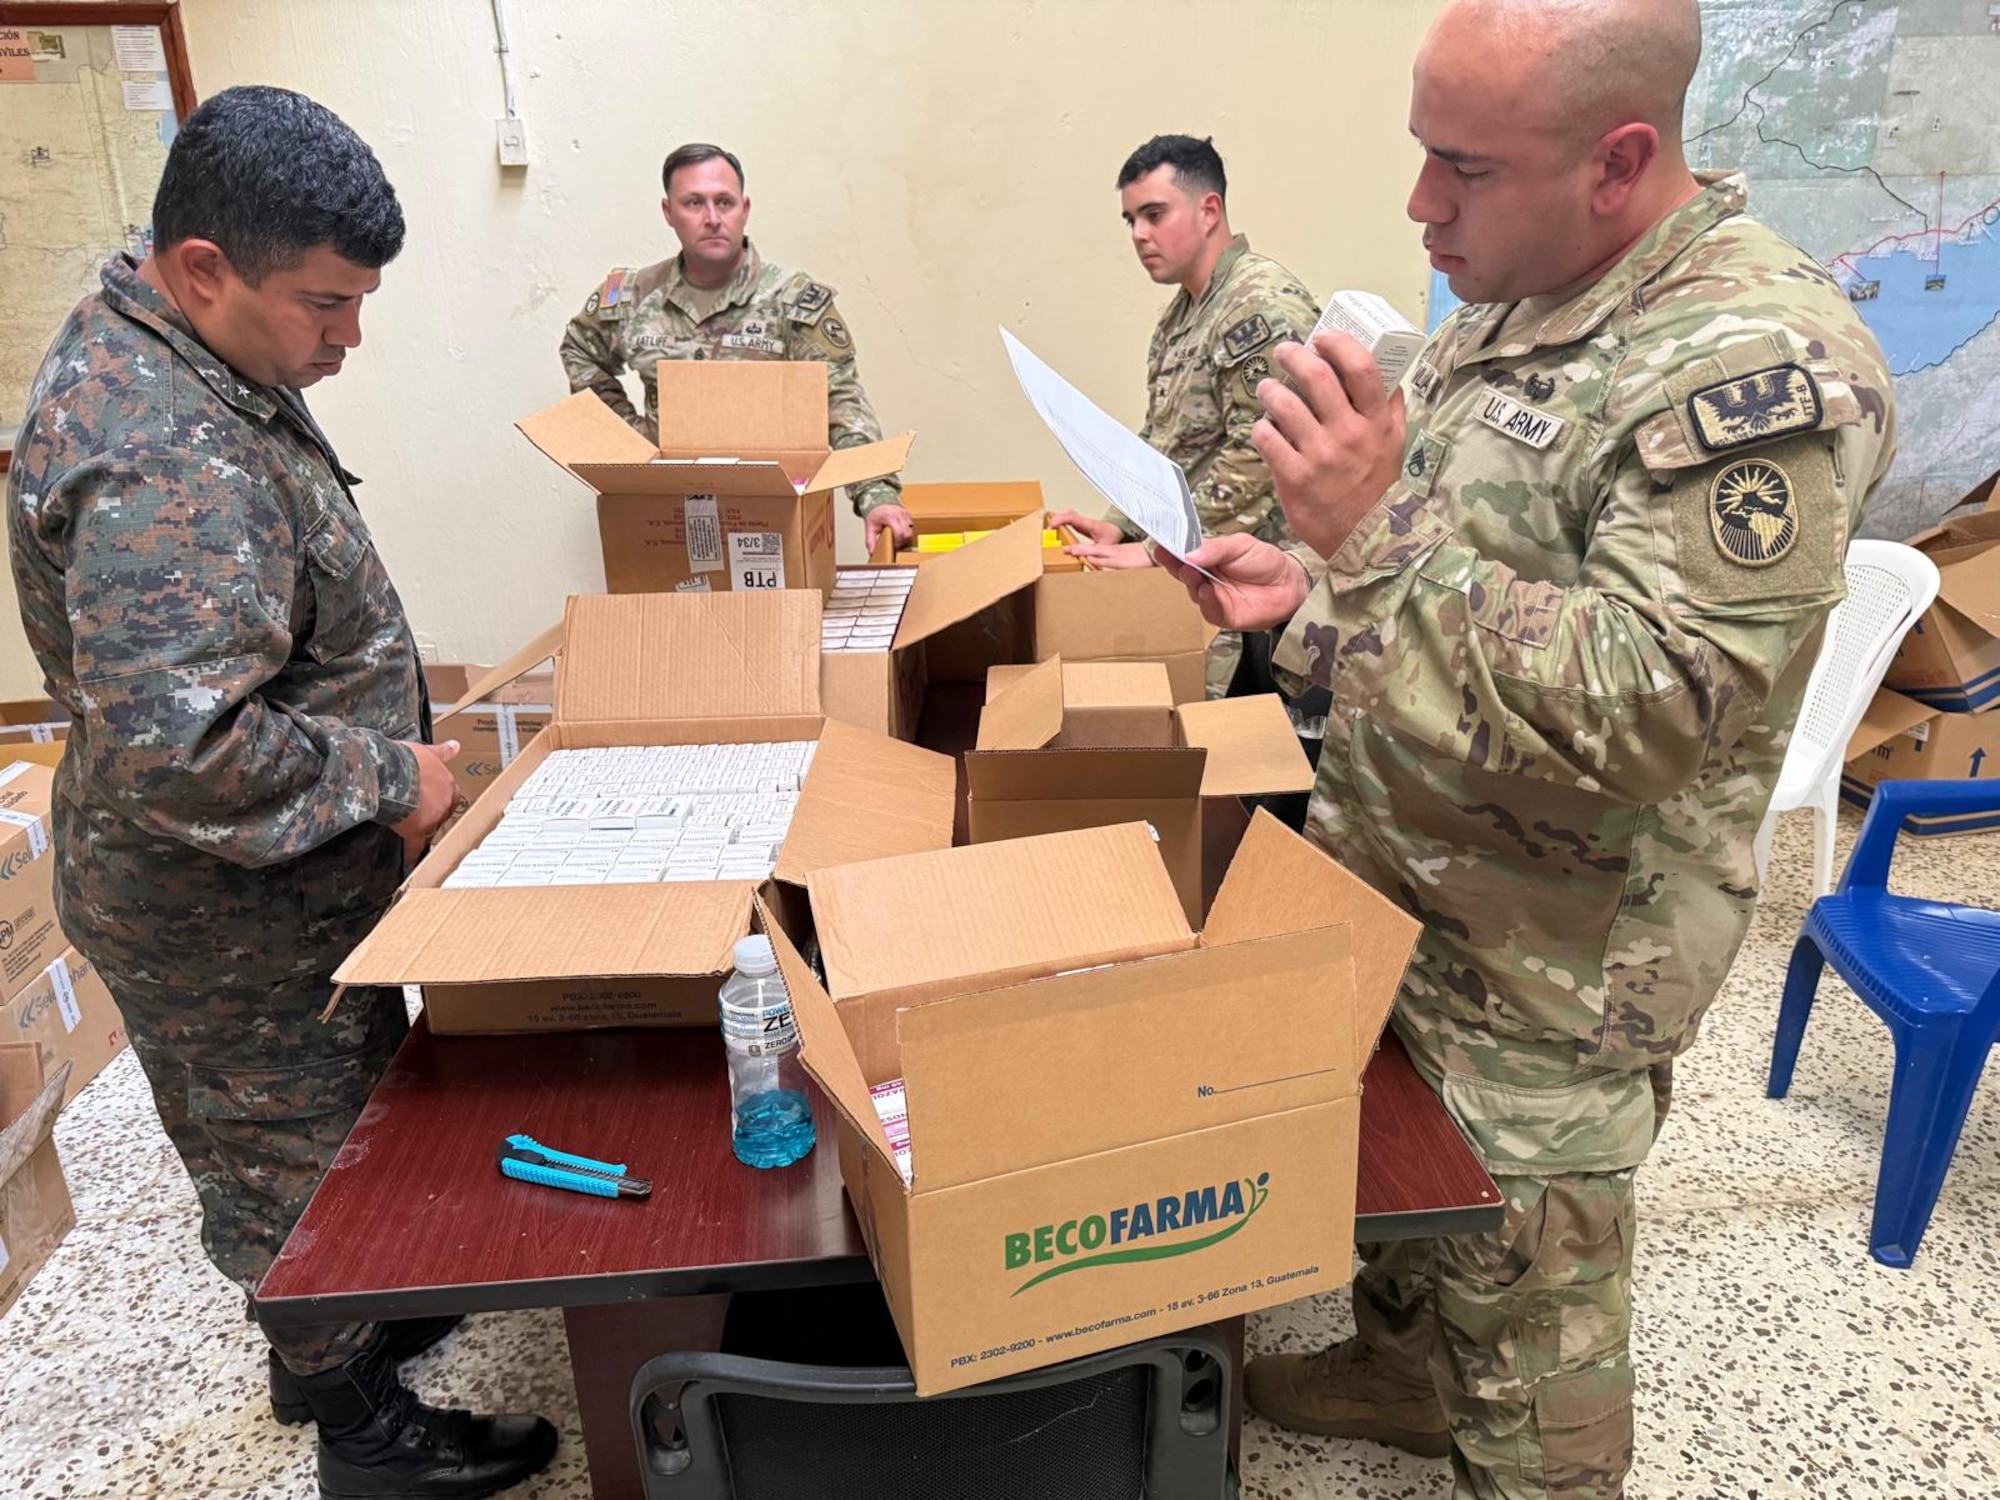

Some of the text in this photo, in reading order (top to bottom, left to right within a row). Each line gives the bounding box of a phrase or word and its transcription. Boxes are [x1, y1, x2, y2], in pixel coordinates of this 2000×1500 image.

[748, 338, 775, 350] ARMY
[1504, 409, 1551, 443] ARMY
[737, 537, 760, 548] 3/34
[744, 571, 777, 588] PTB
[765, 1037, 787, 1049] ZERO
[1197, 1085, 1217, 1098] No.
[1004, 1180, 1245, 1270] BECOFARMA
[950, 1354, 977, 1368] PBX:
[979, 1338, 1035, 1361] 2302-9200
[1045, 1308, 1156, 1344] www.becofarma.com
[1167, 1302, 1179, 1312] 15
[1181, 1298, 1195, 1309] av.
[1197, 1290, 1220, 1304] 3-66
[1222, 1284, 1248, 1297] Zona
[1250, 1279, 1265, 1289] 13,
[1266, 1264, 1319, 1286] Guatemala
